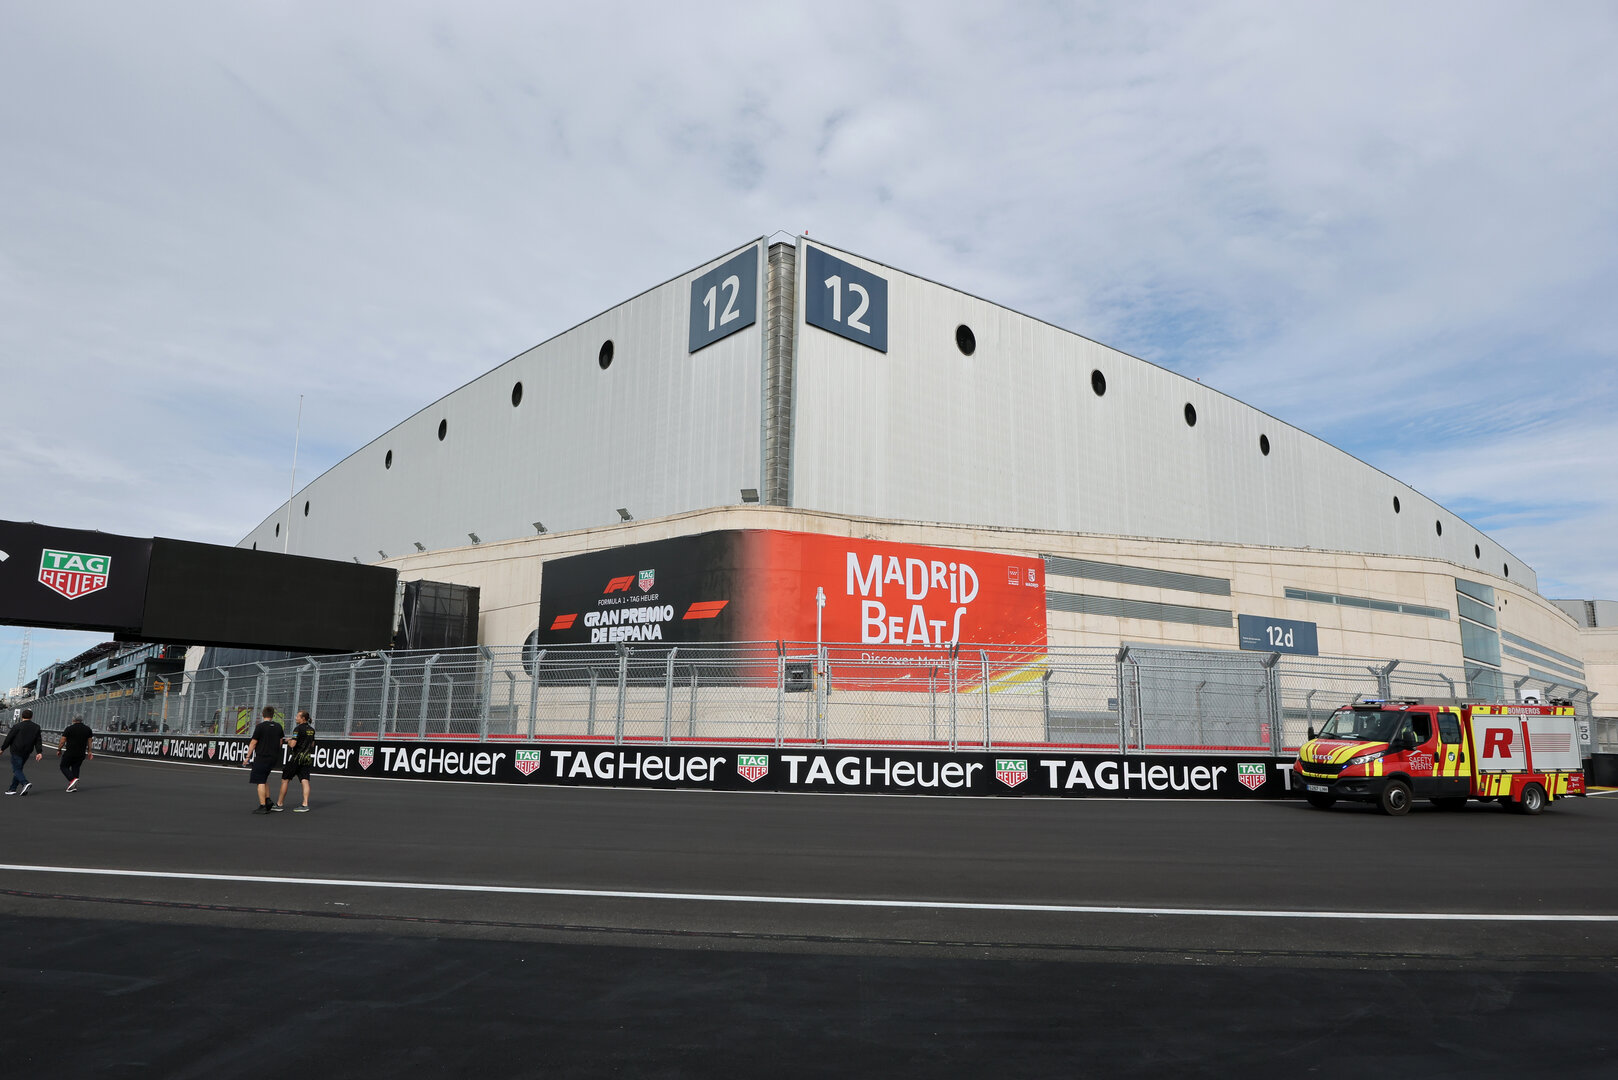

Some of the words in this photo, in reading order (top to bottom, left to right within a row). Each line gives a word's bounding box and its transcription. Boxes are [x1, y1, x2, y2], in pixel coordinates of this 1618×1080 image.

[702, 274, 740, 332] 12
[824, 274, 871, 334] 12
[48, 552, 104, 573] TAG
[640, 571, 653, 579] TAG
[42, 571, 104, 596] HEUER
[598, 597, 621, 606] FORMULA
[630, 595, 640, 603] TAG
[640, 593, 659, 602] HEUER
[583, 609, 620, 628] GRAN
[620, 604, 674, 624] PREMIO
[591, 627, 608, 643] DE
[608, 622, 662, 642] ESPAÑA
[1266, 625, 1294, 648] 12d
[1507, 707, 1541, 715] BOMBEROS
[1482, 728, 1514, 758] R
[361, 748, 373, 756] TAG
[518, 751, 539, 760] TAG
[740, 756, 766, 766] TAG
[998, 761, 1024, 771] TAG
[1408, 756, 1432, 764] SAFETY
[516, 761, 539, 774] HEUER
[739, 766, 767, 780] HEUER
[1239, 765, 1263, 774] TAG
[1410, 763, 1433, 771] EVENTS
[997, 771, 1026, 785] HEUER
[1239, 775, 1265, 788] HEUER
